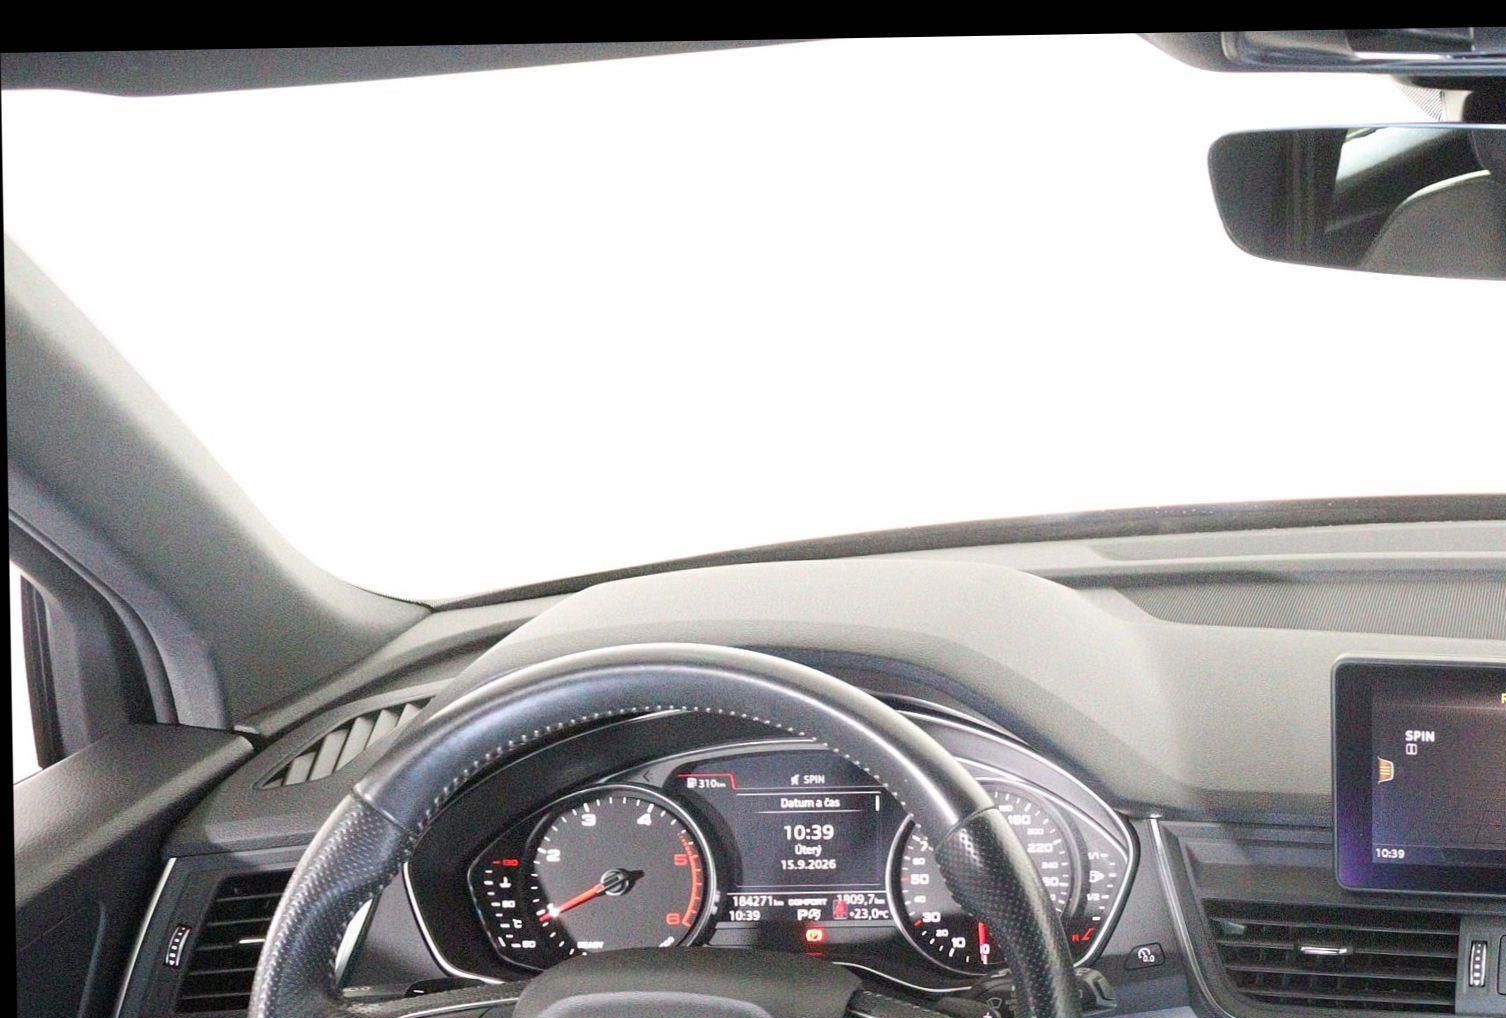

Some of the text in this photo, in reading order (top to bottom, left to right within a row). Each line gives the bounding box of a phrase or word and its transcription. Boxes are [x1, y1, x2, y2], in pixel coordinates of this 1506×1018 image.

[1405, 730, 1435, 742] SPIN
[803, 775, 825, 785] SPIN
[780, 798, 812, 808] Datum
[824, 796, 840, 808] čas
[581, 813, 597, 826] 3
[637, 814, 651, 826] 4
[783, 824, 834, 840] 10:39
[546, 848, 560, 862] 2
[674, 853, 688, 866] 5
[1375, 847, 1405, 860] 10:39
[780, 859, 837, 870] 15.9.2026
[910, 873, 929, 885] 50
[666, 913, 680, 925] 6
[729, 910, 761, 921] 10:39
[922, 912, 941, 923] 30
[951, 937, 966, 948] 10
[980, 943, 990, 955] 0
